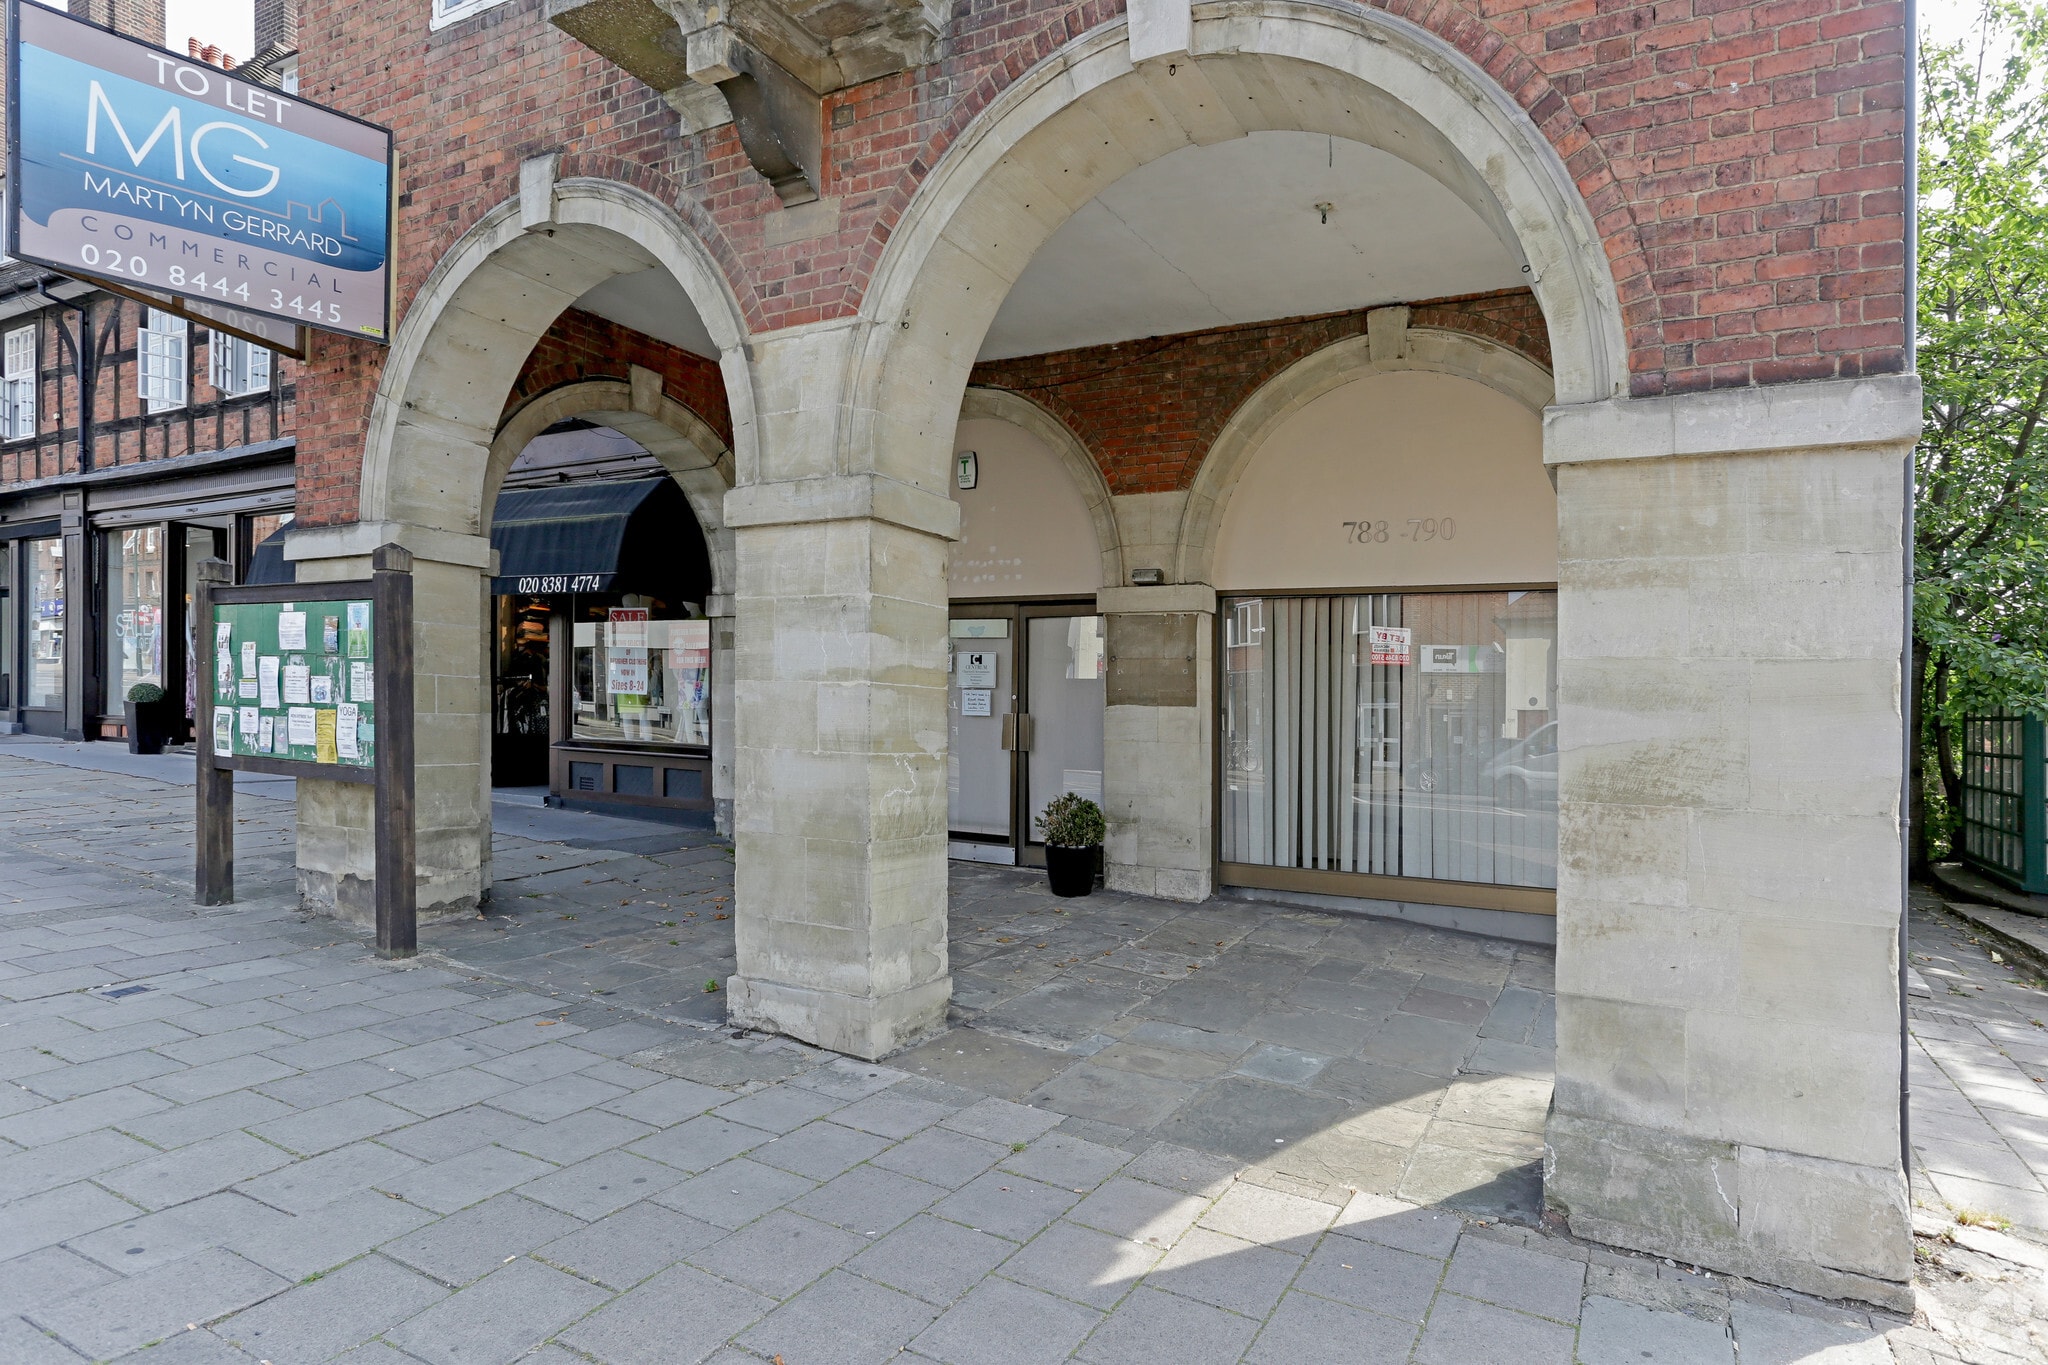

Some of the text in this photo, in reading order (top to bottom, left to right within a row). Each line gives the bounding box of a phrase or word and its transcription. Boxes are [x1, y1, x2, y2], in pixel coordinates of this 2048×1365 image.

[147, 53, 291, 123] TO LET
[86, 80, 280, 198] MG
[84, 171, 342, 257] MARTYN GERRARD
[81, 215, 343, 294] COMMERCIAL
[81, 243, 342, 323] 020 8444 3445
[1343, 520, 1389, 544] 788
[519, 575, 600, 593] 020 8381 4774
[611, 612, 645, 621] SALE
[611, 680, 645, 691] Sizes 8-24
[339, 707, 357, 716] YOGA
